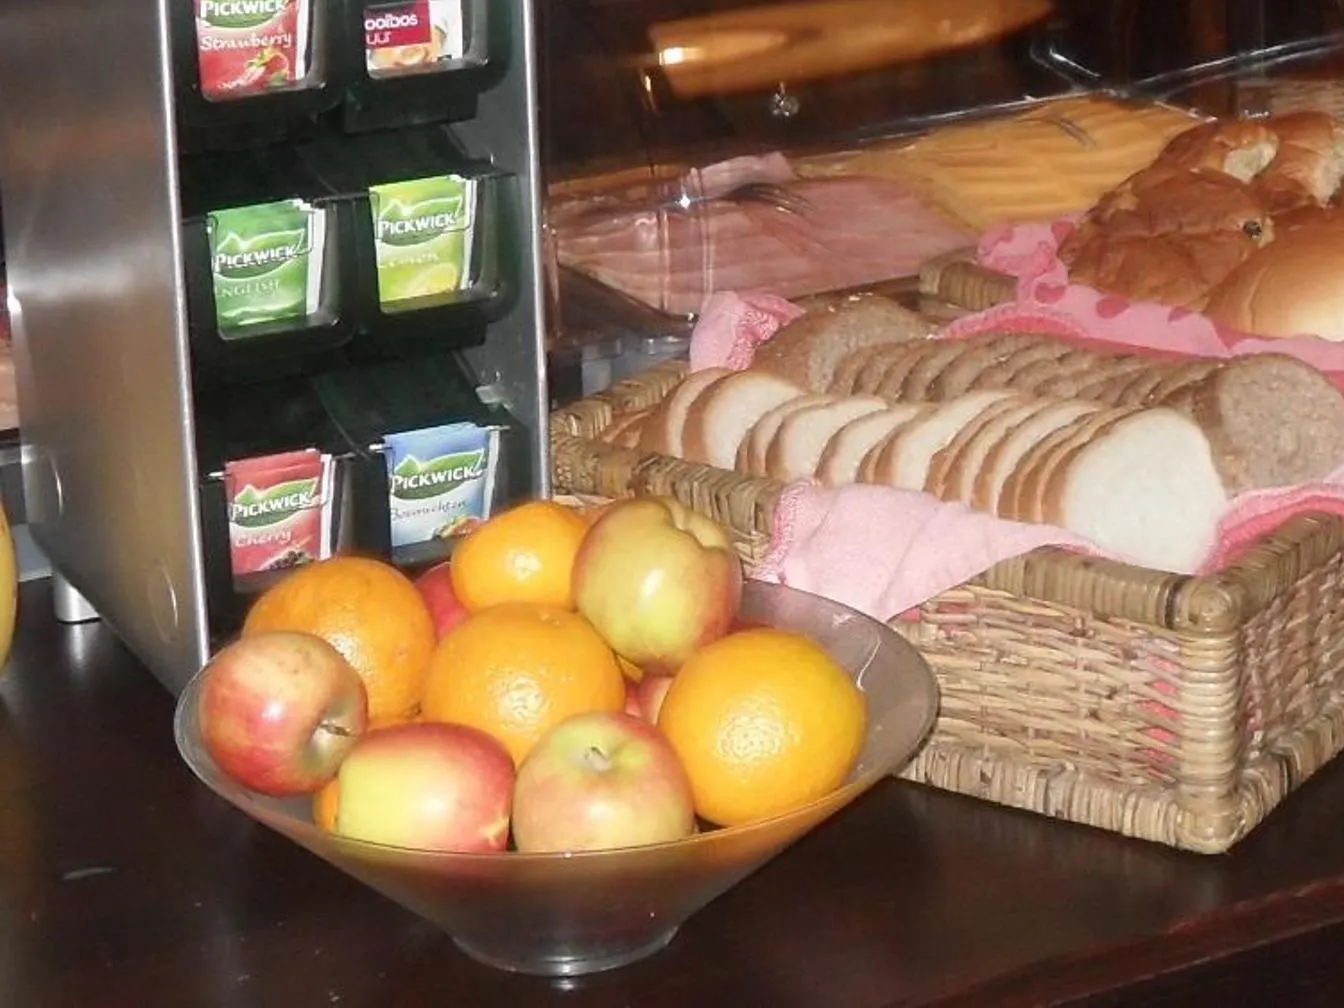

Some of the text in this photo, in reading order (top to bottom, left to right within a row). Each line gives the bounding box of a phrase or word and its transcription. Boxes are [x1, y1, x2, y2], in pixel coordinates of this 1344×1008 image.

[364, 13, 418, 31] ooibos
[200, 26, 292, 51] Strawberry
[378, 213, 456, 239] PICKWICK
[213, 245, 299, 273] PICKWICK
[220, 278, 281, 298] NGLISH
[391, 466, 474, 496] PICKWICK
[231, 491, 311, 521] PICKWICK
[235, 531, 292, 549] Cherry
